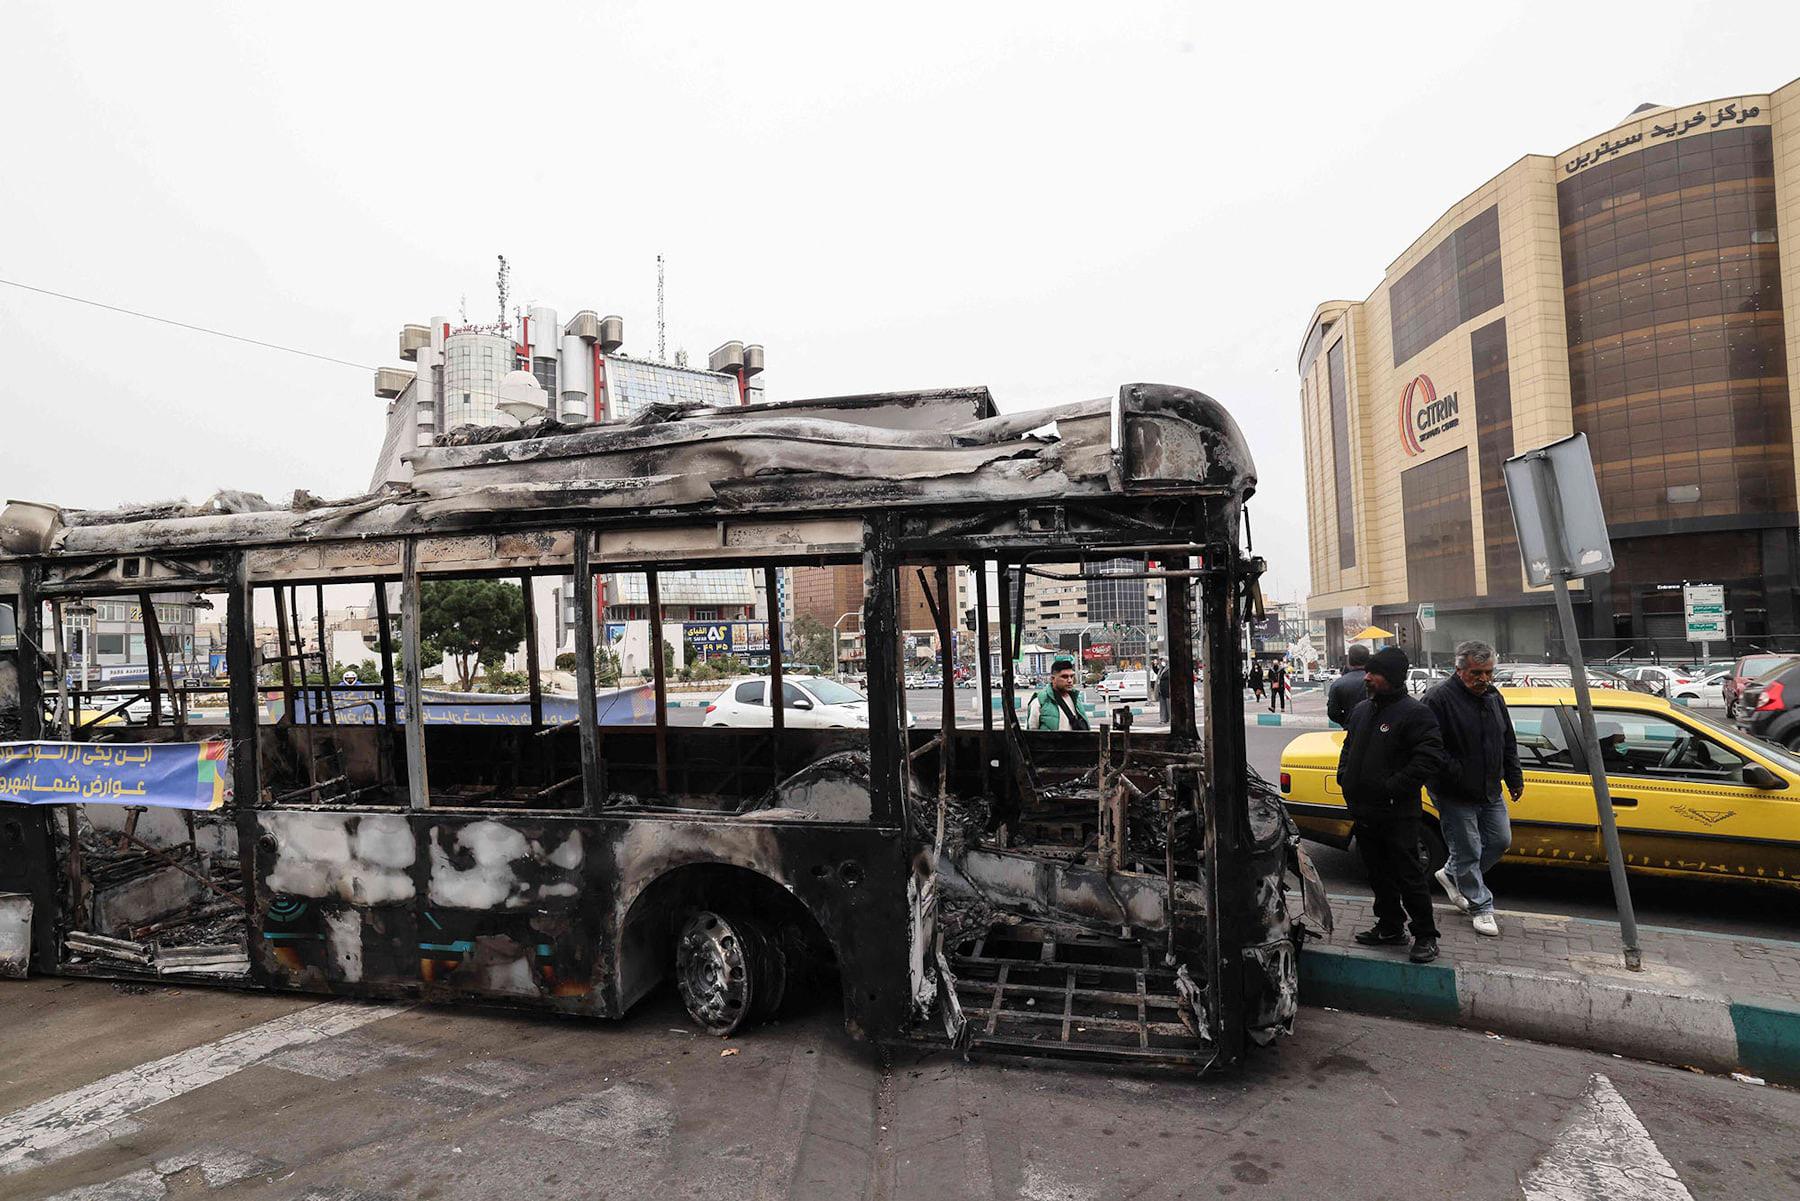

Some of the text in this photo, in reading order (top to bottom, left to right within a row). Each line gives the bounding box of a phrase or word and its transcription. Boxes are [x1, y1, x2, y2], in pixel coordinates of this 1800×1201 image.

[1565, 103, 1760, 173] مرکز خرید سیترین
[1417, 391, 1459, 431] CITRIN
[82, 746, 112, 767] یکی
[114, 746, 151, 767] این
[31, 774, 80, 793] شما
[82, 774, 146, 798] عوارض
